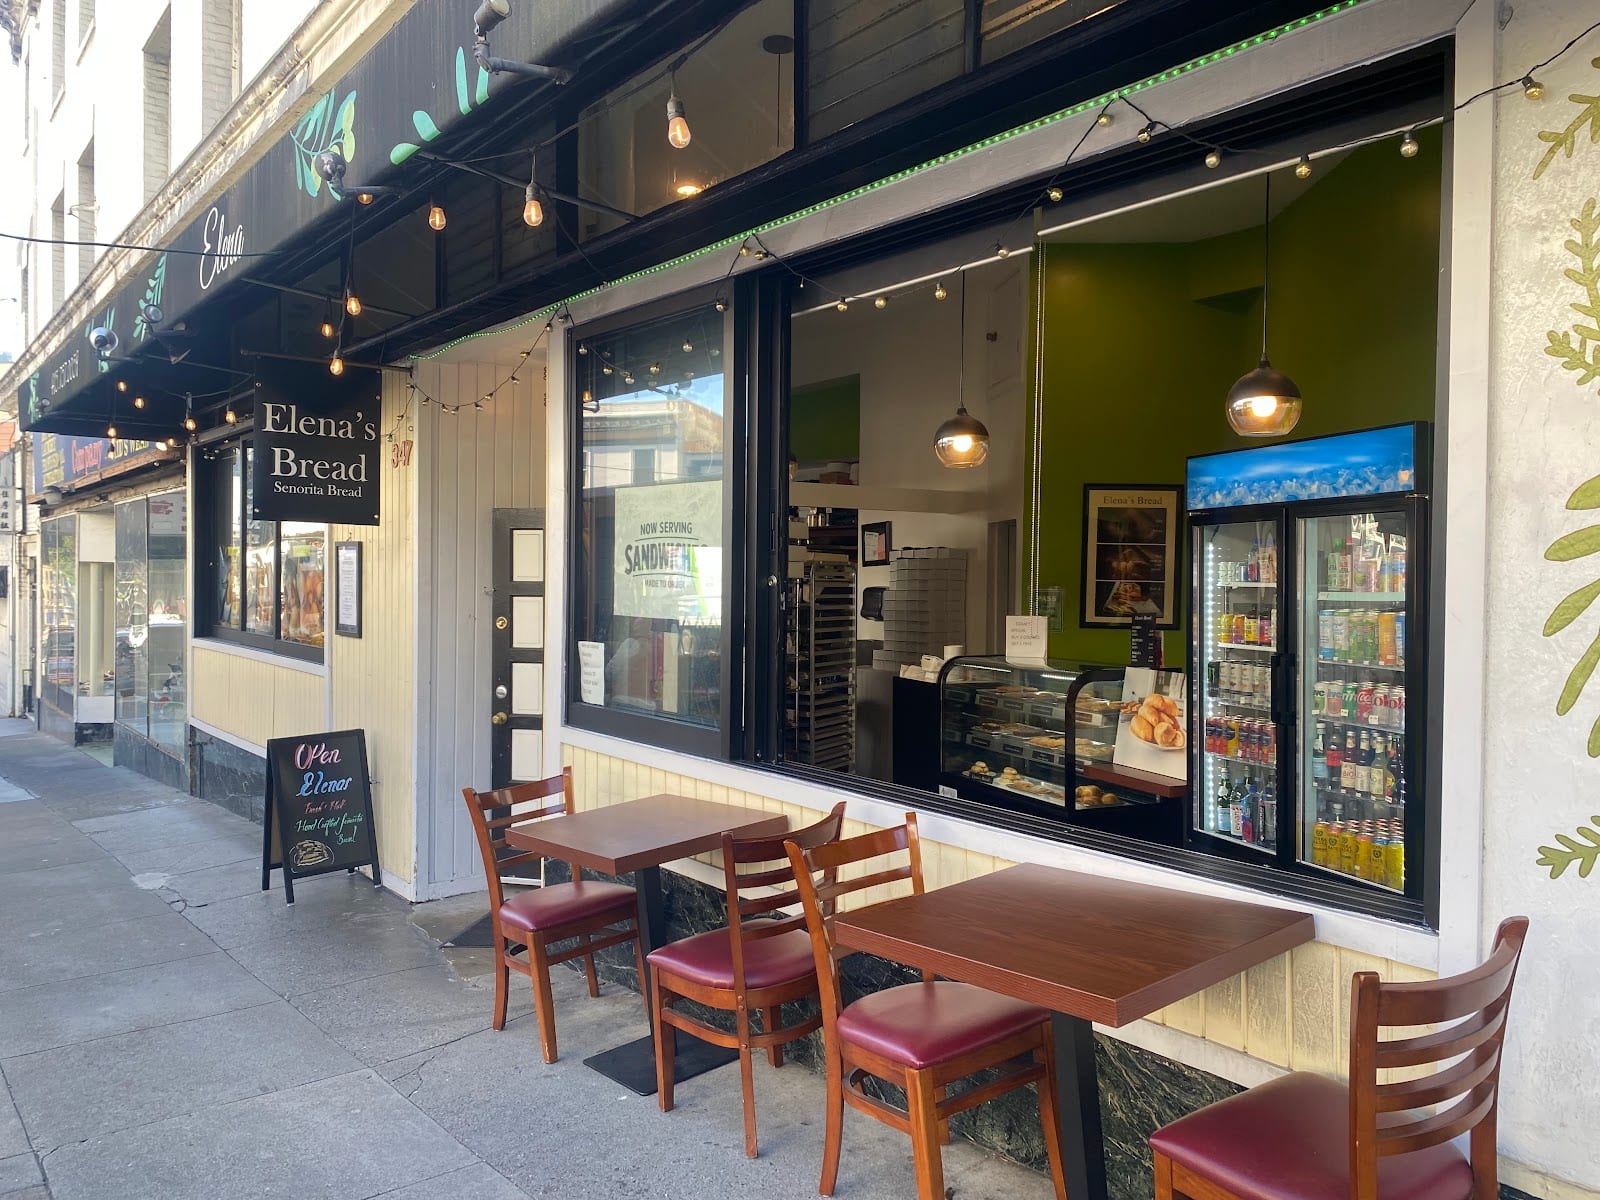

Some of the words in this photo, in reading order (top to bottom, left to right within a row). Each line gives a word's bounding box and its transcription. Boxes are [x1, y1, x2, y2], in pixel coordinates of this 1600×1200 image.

[200, 207, 244, 289] Elena
[262, 403, 376, 441] Elena's
[270, 447, 368, 482] Bread
[392, 440, 413, 468] 347
[273, 481, 323, 496] Senorita
[327, 484, 362, 498] Bread
[1103, 496, 1134, 505] Elena's
[1137, 497, 1163, 505] Bread
[640, 522, 657, 535] NOW
[659, 521, 693, 534] SERVING
[294, 743, 341, 770] Open
